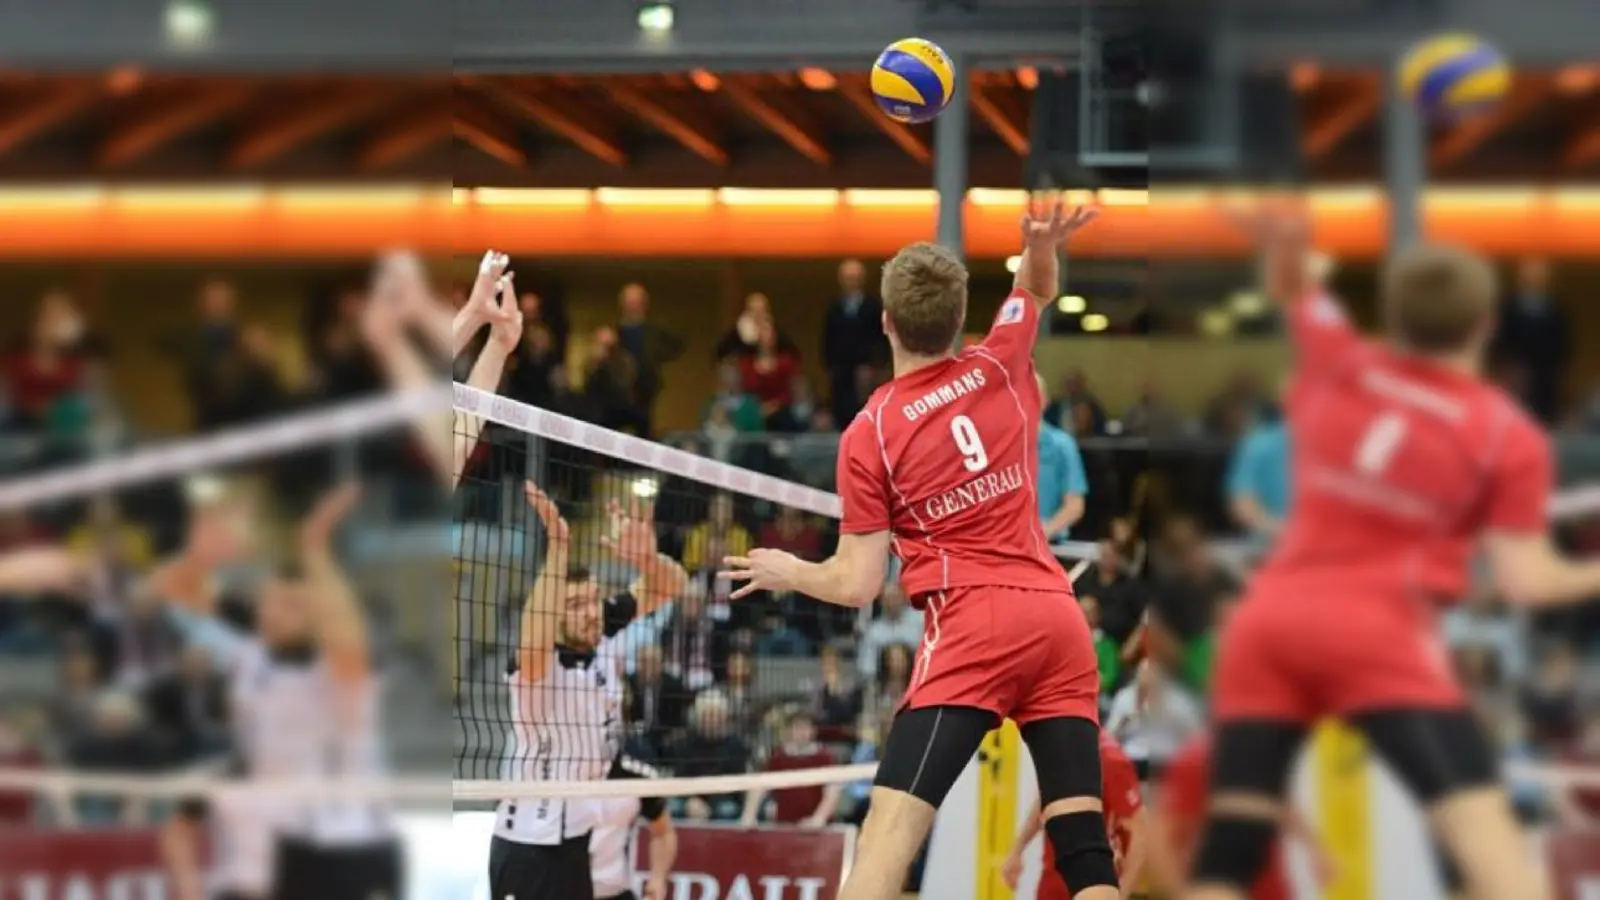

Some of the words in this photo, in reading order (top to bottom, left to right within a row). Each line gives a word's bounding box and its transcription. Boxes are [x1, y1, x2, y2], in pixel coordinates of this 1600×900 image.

[903, 368, 986, 421] GOMMANS
[950, 414, 988, 472] 9
[926, 464, 1022, 519] GENERALI
